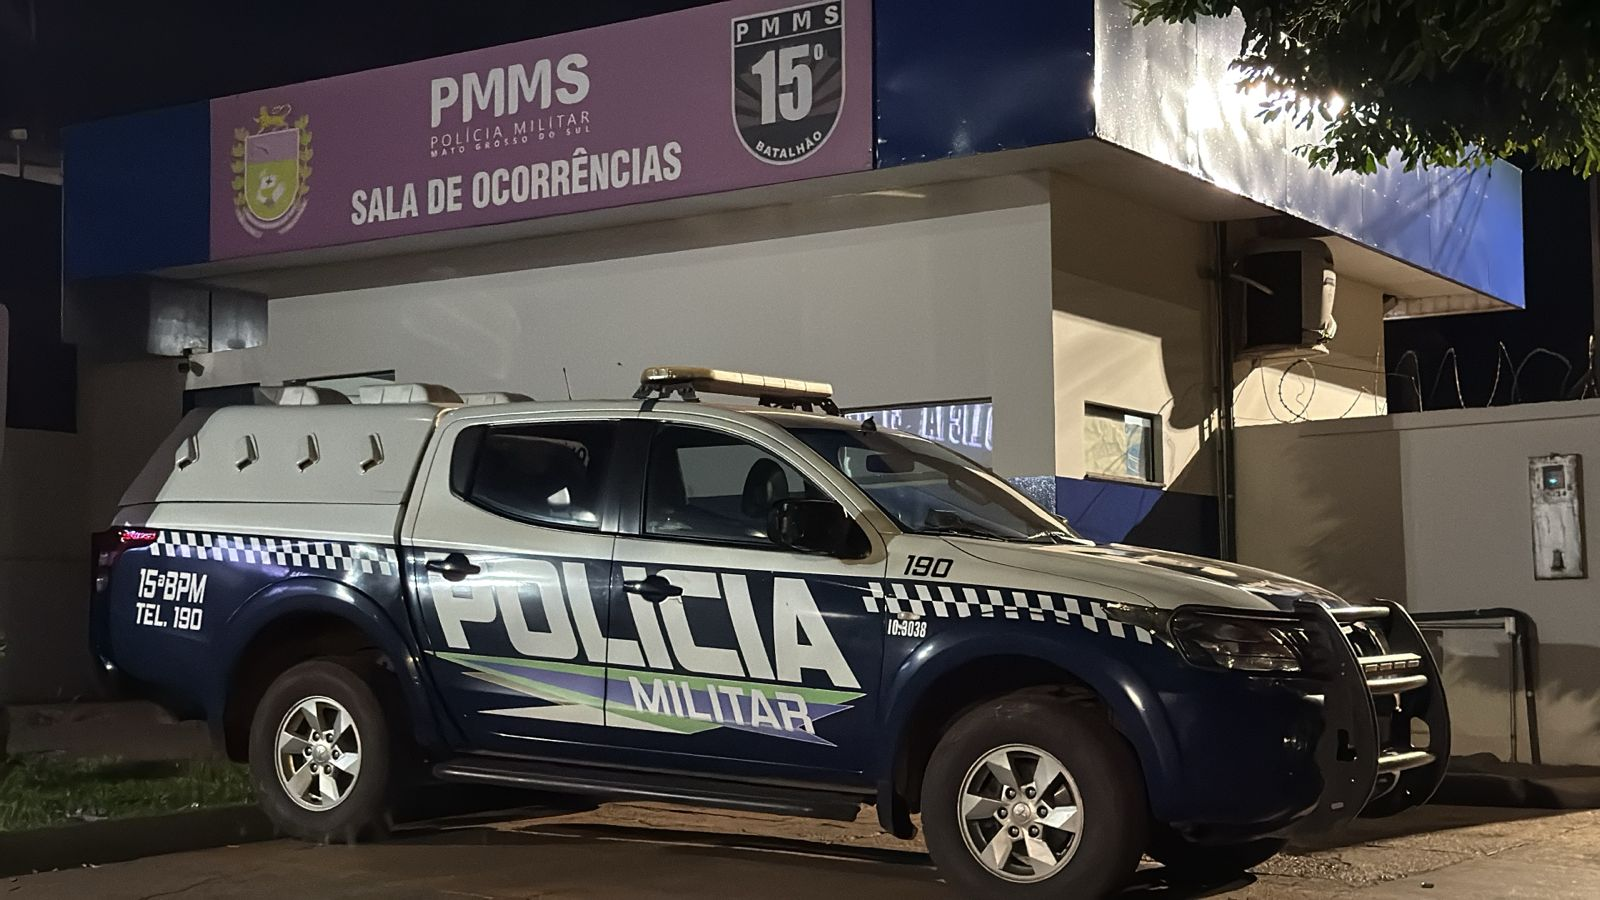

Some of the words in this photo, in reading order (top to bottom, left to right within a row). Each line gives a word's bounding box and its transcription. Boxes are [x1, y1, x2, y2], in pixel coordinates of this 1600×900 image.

[736, 5, 840, 43] PMMS
[430, 53, 591, 128] PMMS
[514, 110, 590, 136] MILITAR
[430, 145, 465, 158] MATO
[475, 135, 528, 151] GROSSO
[538, 131, 555, 141] DO
[566, 125, 591, 137] SUL
[755, 130, 823, 159] BATALHÃO
[351, 182, 419, 226] SALA
[427, 175, 463, 215] DE
[472, 141, 683, 210] OCORRÊNCIAS
[903, 554, 954, 578] 190
[136, 602, 168, 627] TEL.
[173, 606, 203, 631] 190
[628, 676, 816, 735] MILITAR
